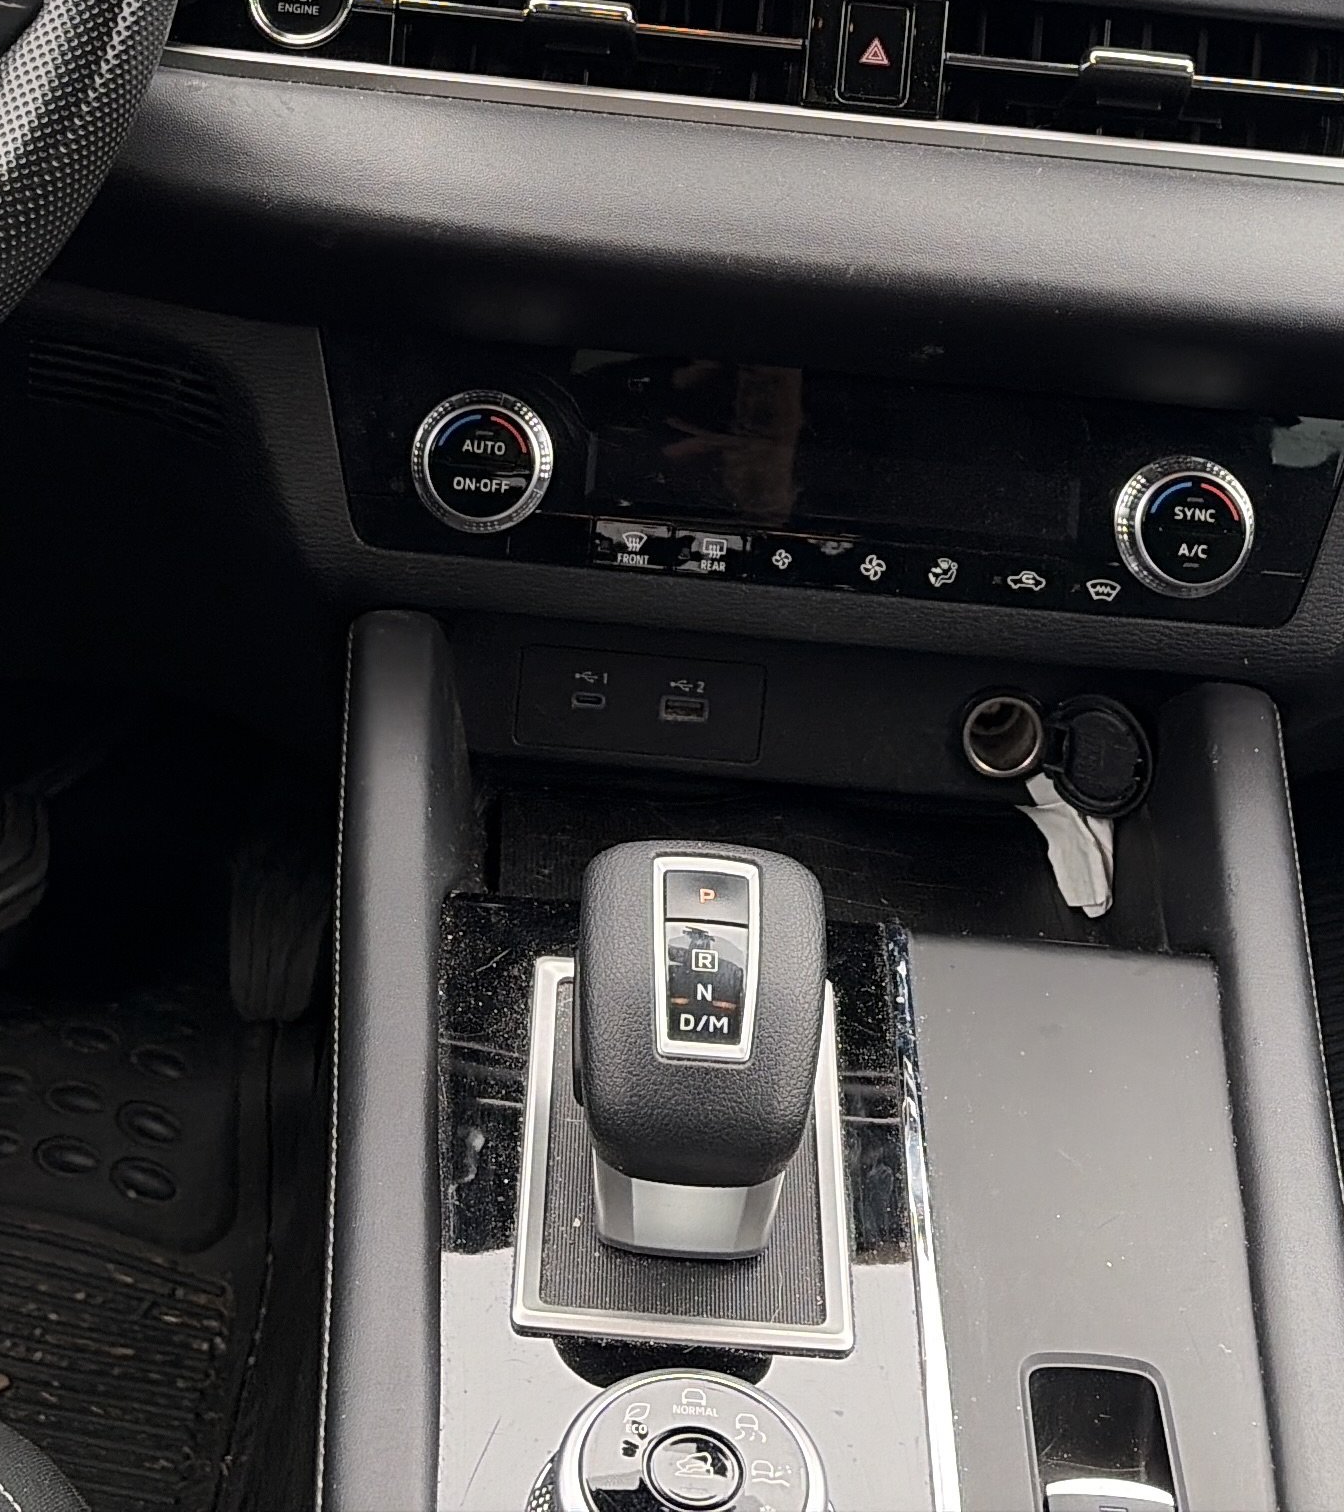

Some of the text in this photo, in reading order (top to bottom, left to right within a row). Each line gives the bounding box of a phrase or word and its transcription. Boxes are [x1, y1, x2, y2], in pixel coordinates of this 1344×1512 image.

[277, 2, 320, 16] ENGINE
[462, 439, 506, 457] AUTO
[1174, 506, 1216, 523] SYNC
[1178, 542, 1208, 559] A/C
[616, 552, 650, 566] FRONT
[700, 559, 726, 572] REAR
[696, 681, 705, 693] 2
[699, 888, 716, 904] P
[696, 983, 712, 1002] N
[679, 1014, 729, 1034] D/M
[672, 1404, 719, 1417] NORMAL
[625, 1423, 648, 1434] ECO
